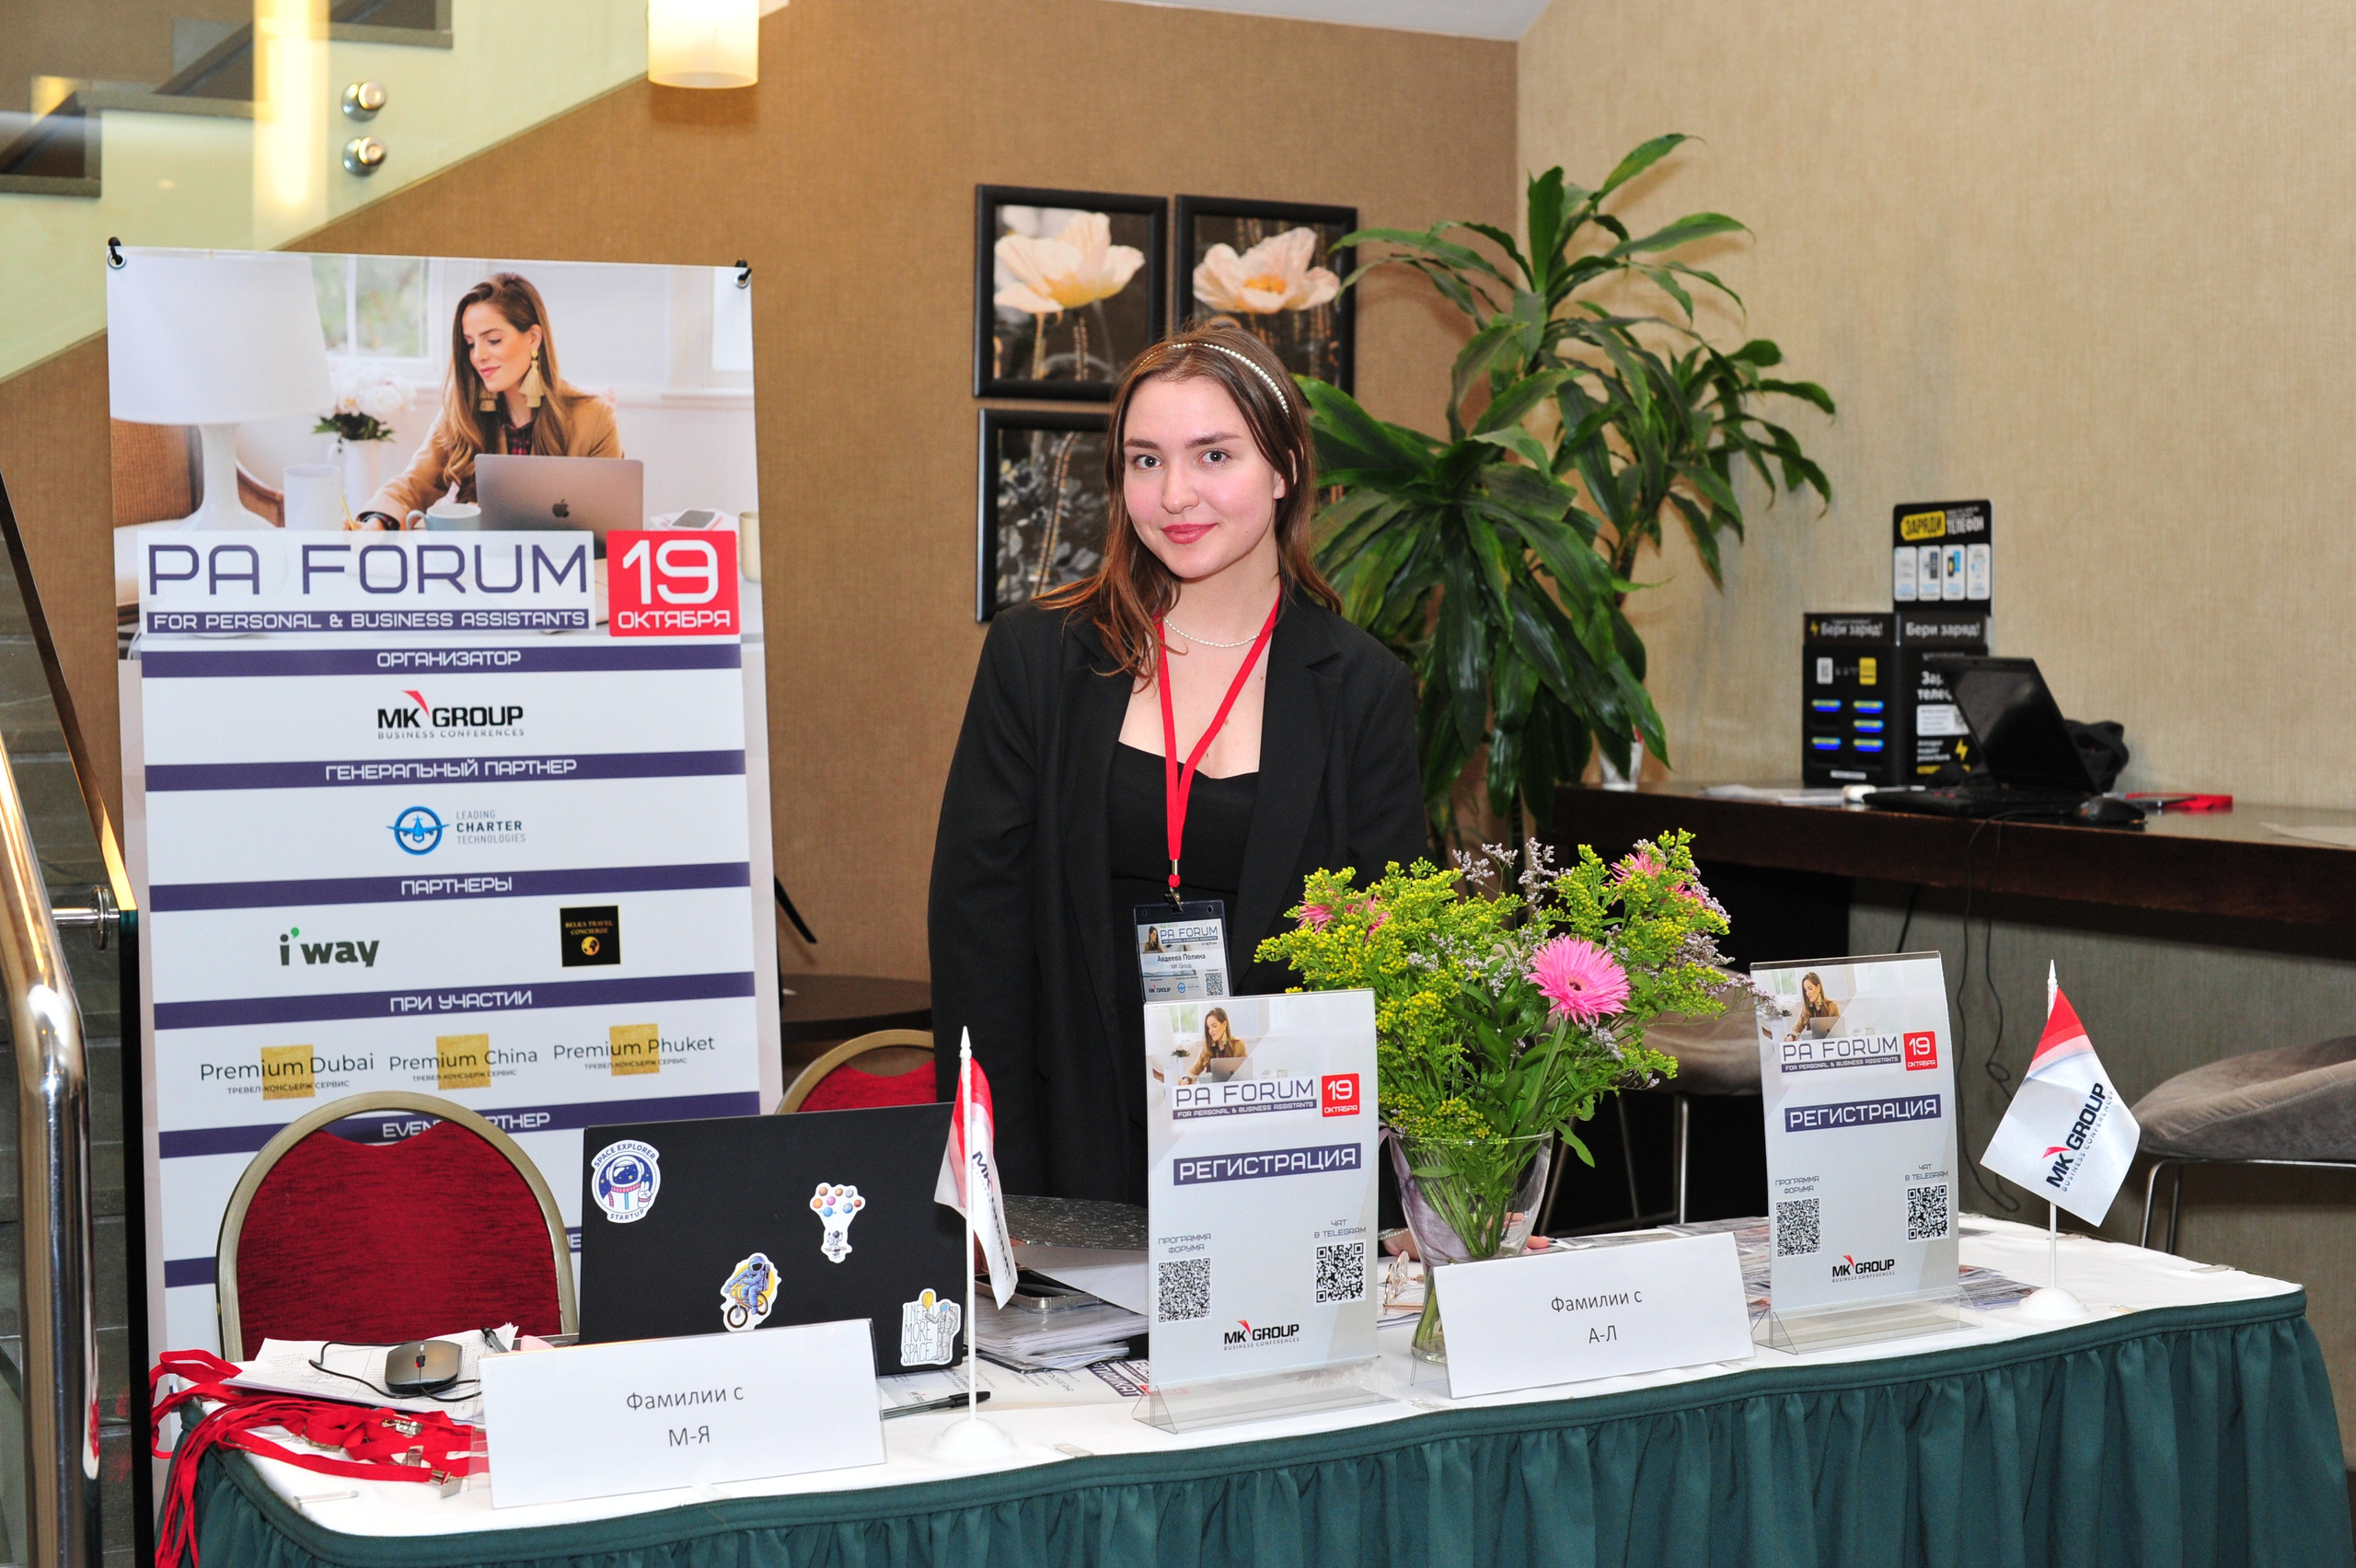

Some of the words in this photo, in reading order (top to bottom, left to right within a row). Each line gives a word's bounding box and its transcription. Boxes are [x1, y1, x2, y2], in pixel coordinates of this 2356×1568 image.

[148, 544, 260, 595] PA
[302, 544, 587, 595] FORUM
[622, 539, 720, 605] 19
[154, 614, 198, 630] FOR
[205, 613, 322, 629] PERSONAL
[329, 613, 343, 628] &
[351, 612, 454, 628] BUSINESS
[461, 611, 586, 628] ASSISTANTS
[618, 609, 731, 629] ОКТЯБРЯ
[1905, 621, 1938, 639] Бери
[1940, 621, 1981, 638] заряд!
[376, 650, 522, 669] ОРГАНИЗАТОР
[377, 708, 422, 729] MK
[432, 705, 525, 728] GROUP
[377, 730, 434, 740] BUSINESS
[440, 728, 525, 738] CONFERENCES
[325, 758, 479, 780] ГЕНЕРАЛЬНЫЙ
[484, 759, 577, 777] ПАРТНЕР
[456, 810, 496, 821] LEADING
[456, 820, 523, 833] CHARTER
[456, 833, 526, 845] TECHNOLOGIES
[400, 876, 513, 895] ПАРТНЕРЫ
[1160, 929, 1175, 939] PA
[1179, 926, 1218, 938] FORUM
[1157, 955, 1183, 963] Авдеева
[1183, 953, 1207, 962] Полина
[389, 995, 433, 1012] ПРИ
[438, 990, 533, 1010] УЧАСТИИ
[553, 1041, 641, 1060] Premium
[647, 1036, 716, 1054] Phuket
[1783, 1043, 1813, 1062] PA
[1822, 1035, 1899, 1058] FORUM
[1909, 1036, 1931, 1056] 19
[200, 1058, 304, 1081] Premium
[309, 1052, 375, 1074] Dubai
[389, 1052, 477, 1071] Premium
[484, 1047, 537, 1066] China
[657, 1057, 687, 1066] СЕРВИС
[1799, 1062, 1829, 1070] PERSONAL
[1907, 1059, 1936, 1067] ОКТЯБРЯ
[487, 1068, 517, 1078] СЕРВИС
[226, 1082, 314, 1095] ТРЕВЕЛ-КОНСЬЕРЖ
[314, 1079, 351, 1090] СЕРВИС
[1175, 1087, 1211, 1107] PA
[1223, 1078, 1314, 1103] FORUM
[1327, 1079, 1353, 1101] 19
[1194, 1108, 1230, 1116] PERSONAL
[1238, 1104, 1272, 1113] BUSINESS
[1273, 1101, 1314, 1110] ASSISTANTS
[1323, 1104, 1358, 1114] ОКТЯБРЯ
[1790, 1099, 1937, 1128] РЕГИСТРАЦИЯ
[2046, 1152, 2074, 1189] MK
[2065, 1082, 2108, 1151] GROUP
[2062, 1151, 2086, 1193] BUSINESS
[2083, 1090, 2113, 1150] CONFERENCES
[594, 1147, 616, 1167] SPACE
[617, 1143, 656, 1160] EXPLORER
[1179, 1147, 1357, 1182] РЕГИСТРАЦИЯ
[1774, 1175, 1819, 1187] ПРОГРАММА
[1911, 1170, 1949, 1181] TELEGRAM
[1784, 1185, 1814, 1194] ФОРУМА
[609, 1208, 644, 1220] STARTUP
[1158, 1233, 1212, 1245] ПРОГРАММА
[1322, 1227, 1367, 1238] TELEGRAM
[1168, 1243, 1205, 1253] ФОРУМА
[1831, 1264, 1851, 1278] MK
[1854, 1258, 1896, 1274] GROUP
[1858, 1271, 1896, 1280] CONFERENCES
[1551, 1292, 1630, 1313] Фамилии
[1634, 1290, 1643, 1304] с
[904, 1321, 932, 1343] MORE
[1224, 1331, 1247, 1344] MK
[1252, 1323, 1299, 1341] GROUP
[1588, 1324, 1618, 1344] А-Л
[904, 1342, 932, 1364] SPACE
[1223, 1343, 1254, 1351] BUSINESS
[1255, 1337, 1299, 1347] CONFERENCES
[626, 1387, 727, 1412] Фамилии
[733, 1386, 745, 1401] с
[668, 1425, 710, 1447] М-Я
